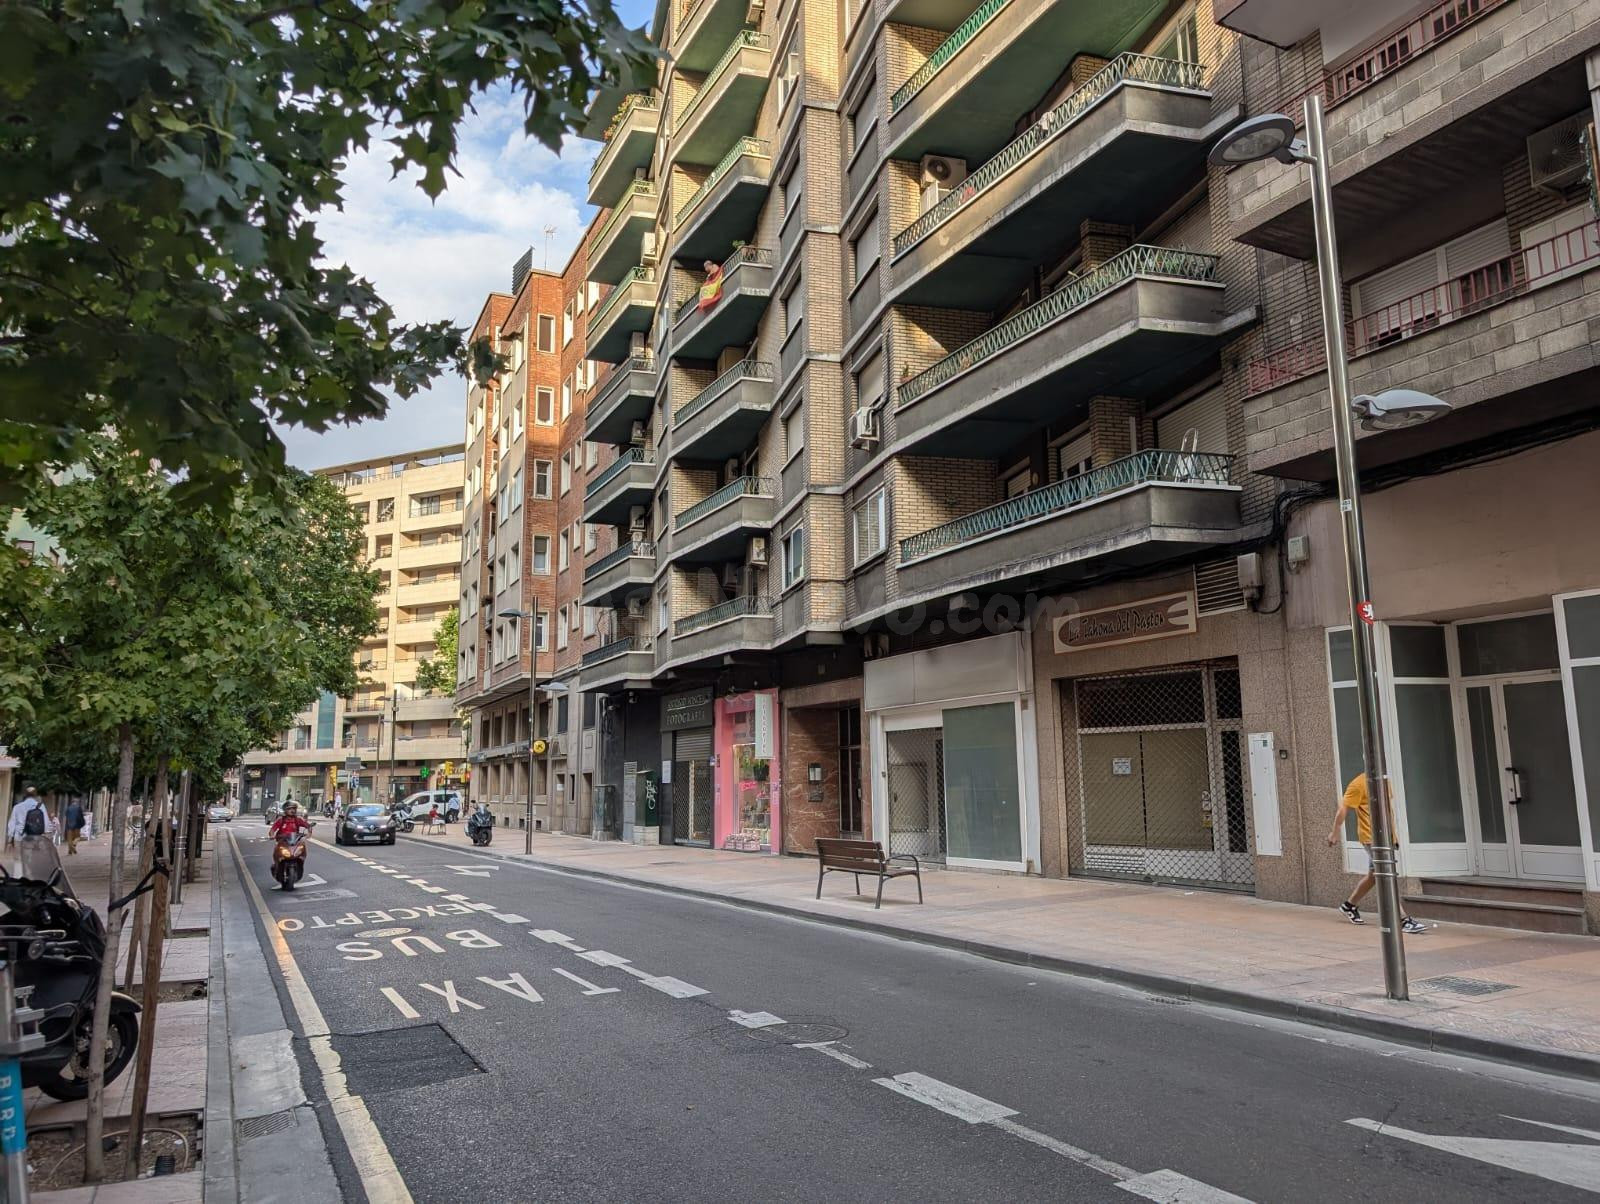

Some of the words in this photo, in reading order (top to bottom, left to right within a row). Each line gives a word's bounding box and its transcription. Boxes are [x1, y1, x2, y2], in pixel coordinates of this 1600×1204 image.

[1068, 620, 1080, 643] La
[1082, 618, 1114, 640] Tahona
[1116, 610, 1130, 633] del
[1132, 610, 1165, 635] Pastor
[277, 902, 478, 932] EXCEPTO
[335, 928, 503, 961] BUS
[379, 967, 622, 1019] TAXI
[0, 1074, 17, 1141] BIRD
